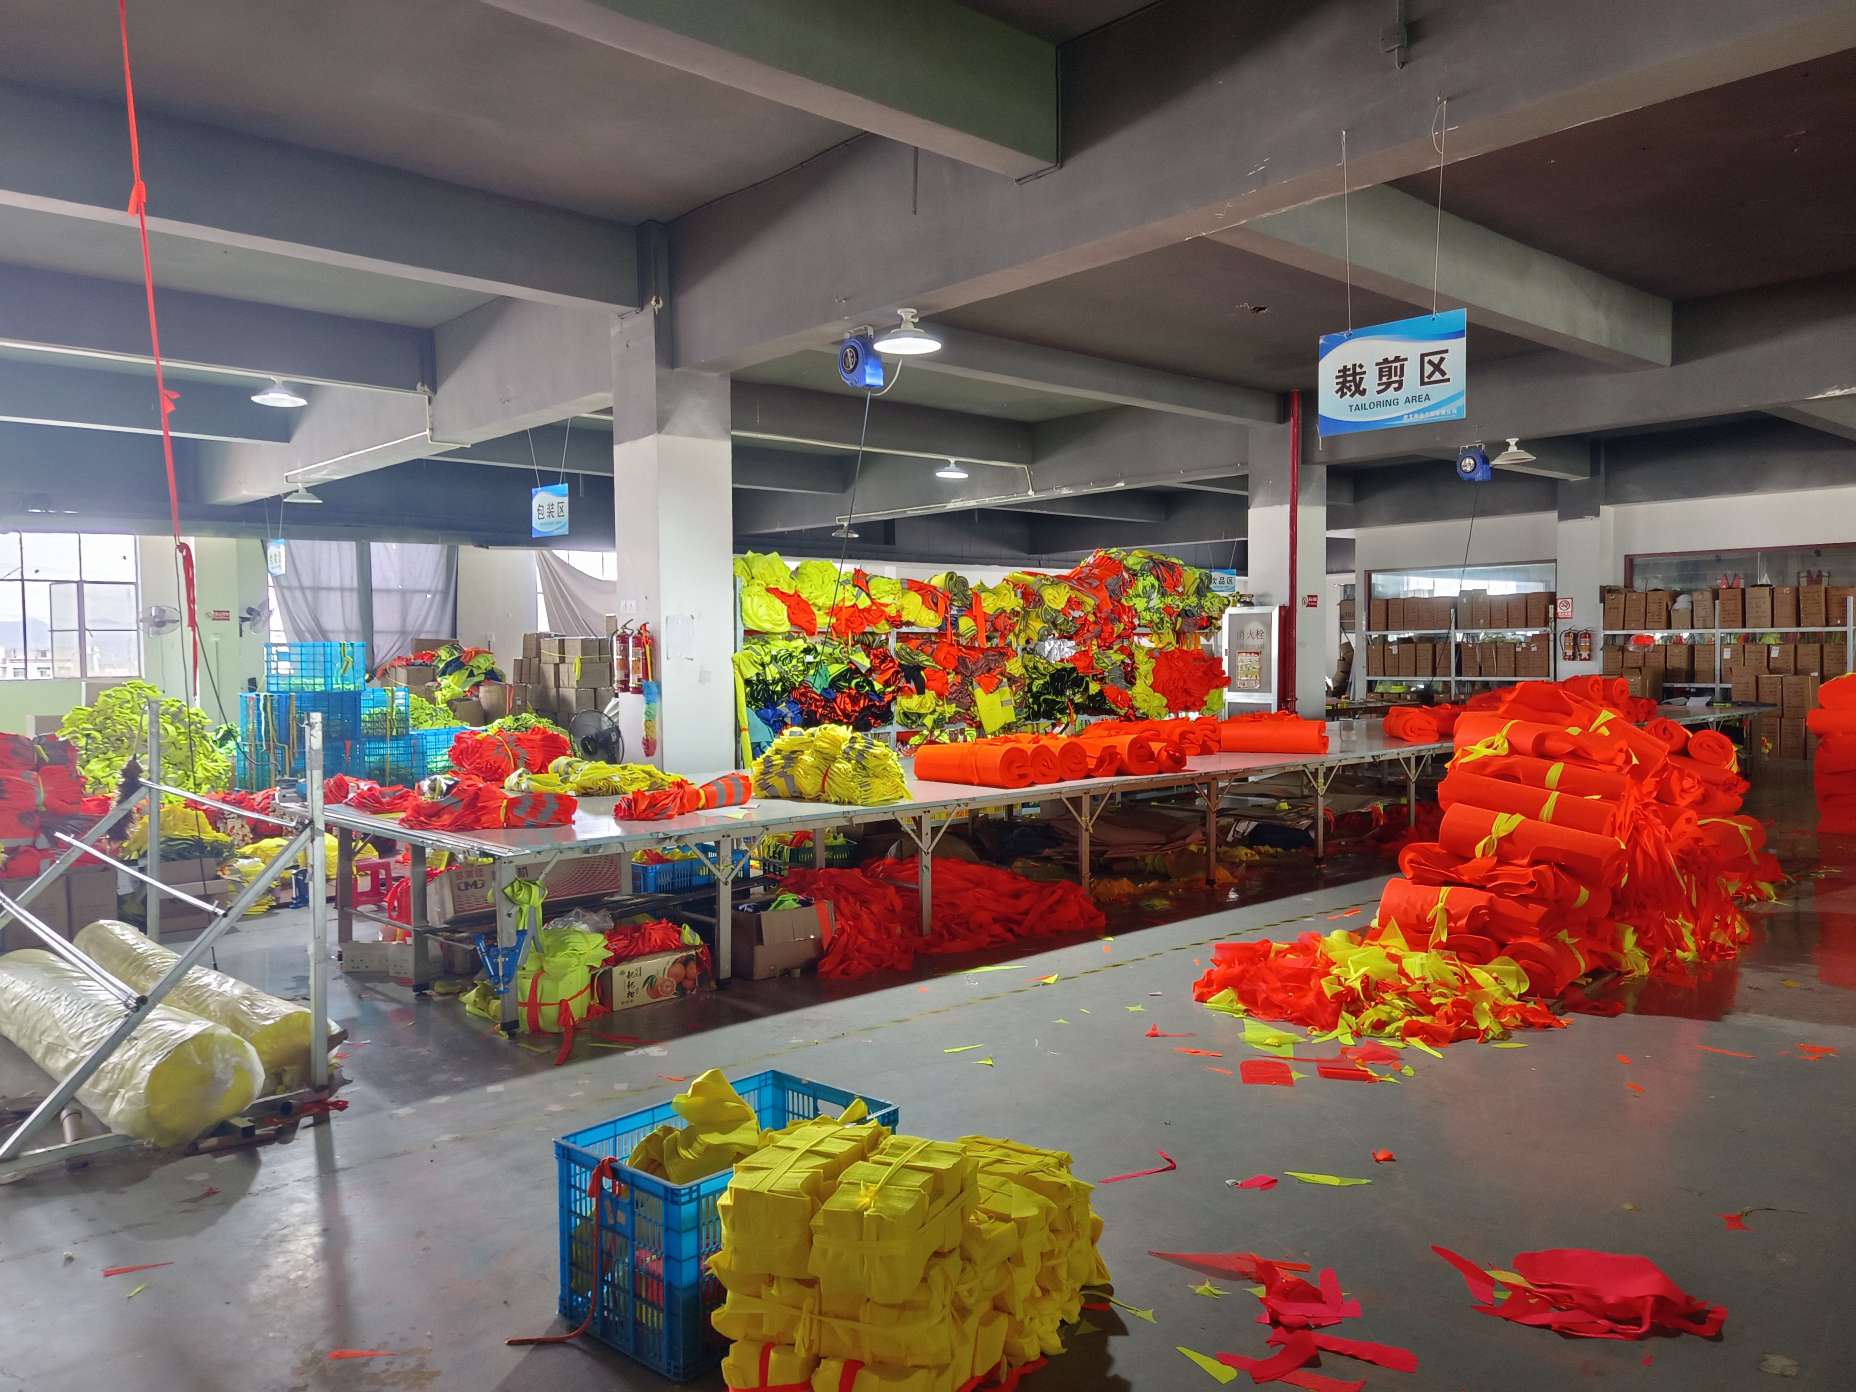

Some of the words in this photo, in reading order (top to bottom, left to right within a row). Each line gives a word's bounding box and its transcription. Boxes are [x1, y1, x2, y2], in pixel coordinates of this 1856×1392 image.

[1335, 349, 1450, 399] 裁剪区
[1348, 398, 1399, 413] TAILORING
[1404, 393, 1431, 405] AREA
[537, 501, 566, 520] 包装区
